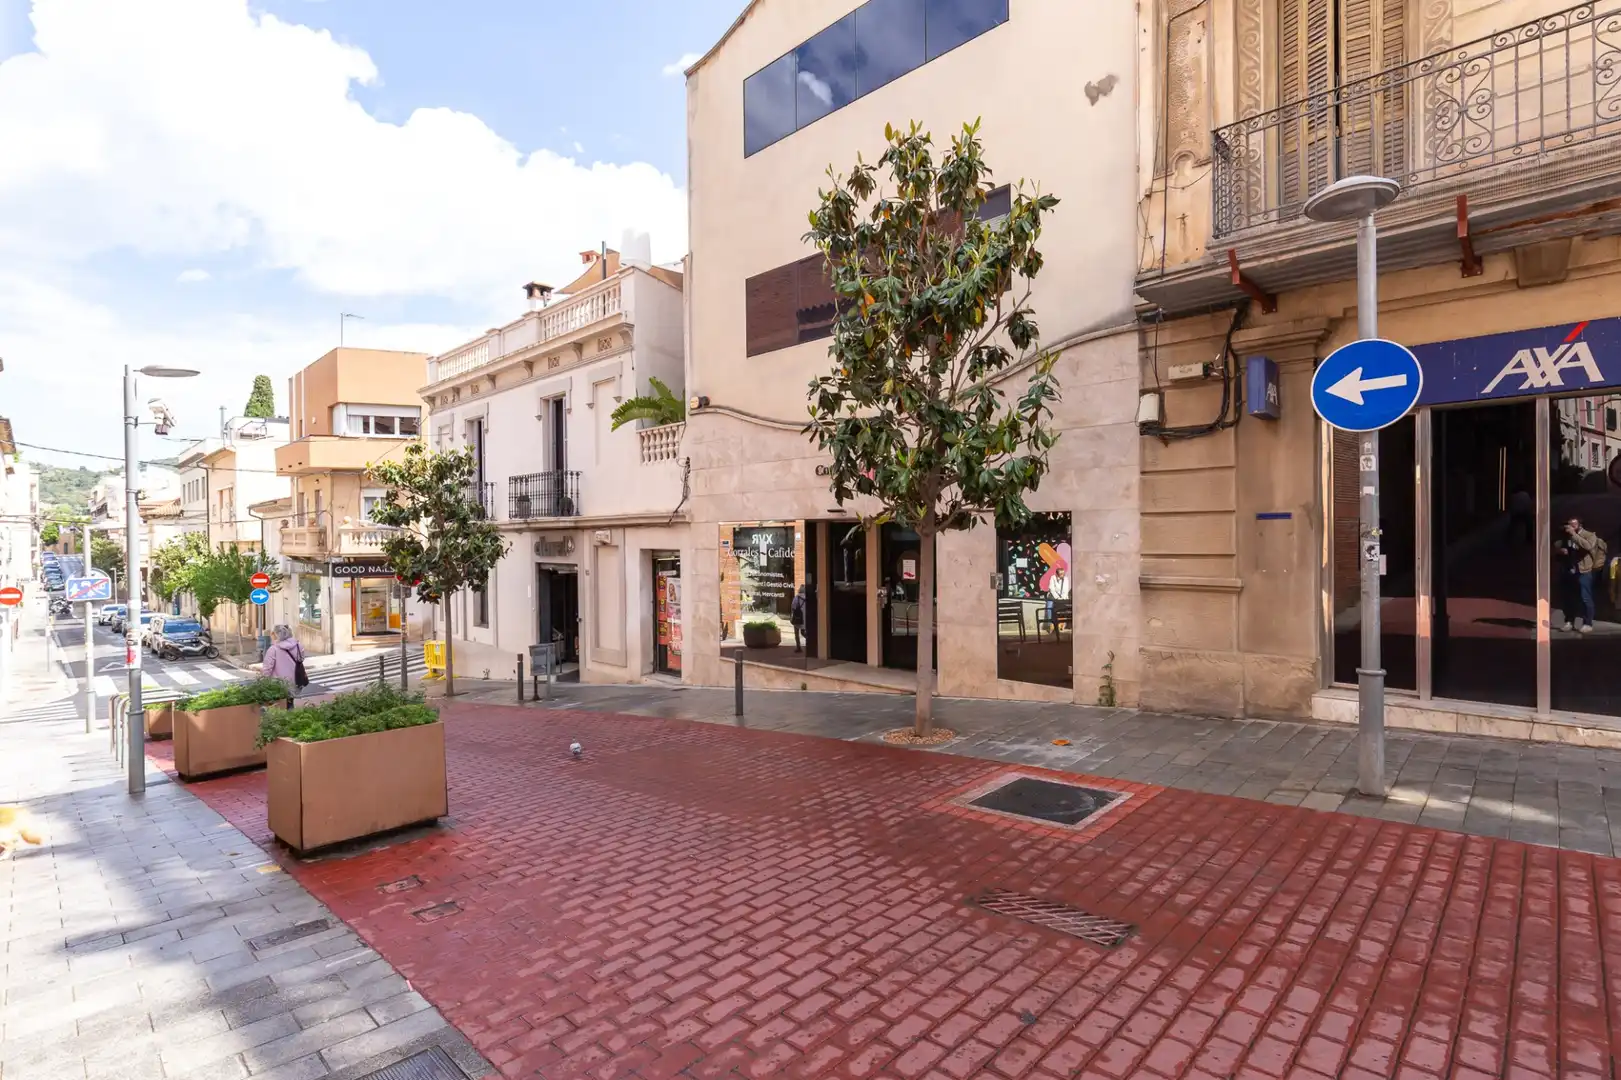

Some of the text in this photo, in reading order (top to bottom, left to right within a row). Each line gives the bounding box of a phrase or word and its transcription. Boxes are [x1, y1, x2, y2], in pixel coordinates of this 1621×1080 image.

[1480, 342, 1605, 394] AXA
[1265, 382, 1278, 405] AXA
[334, 565, 366, 574] GOOD
